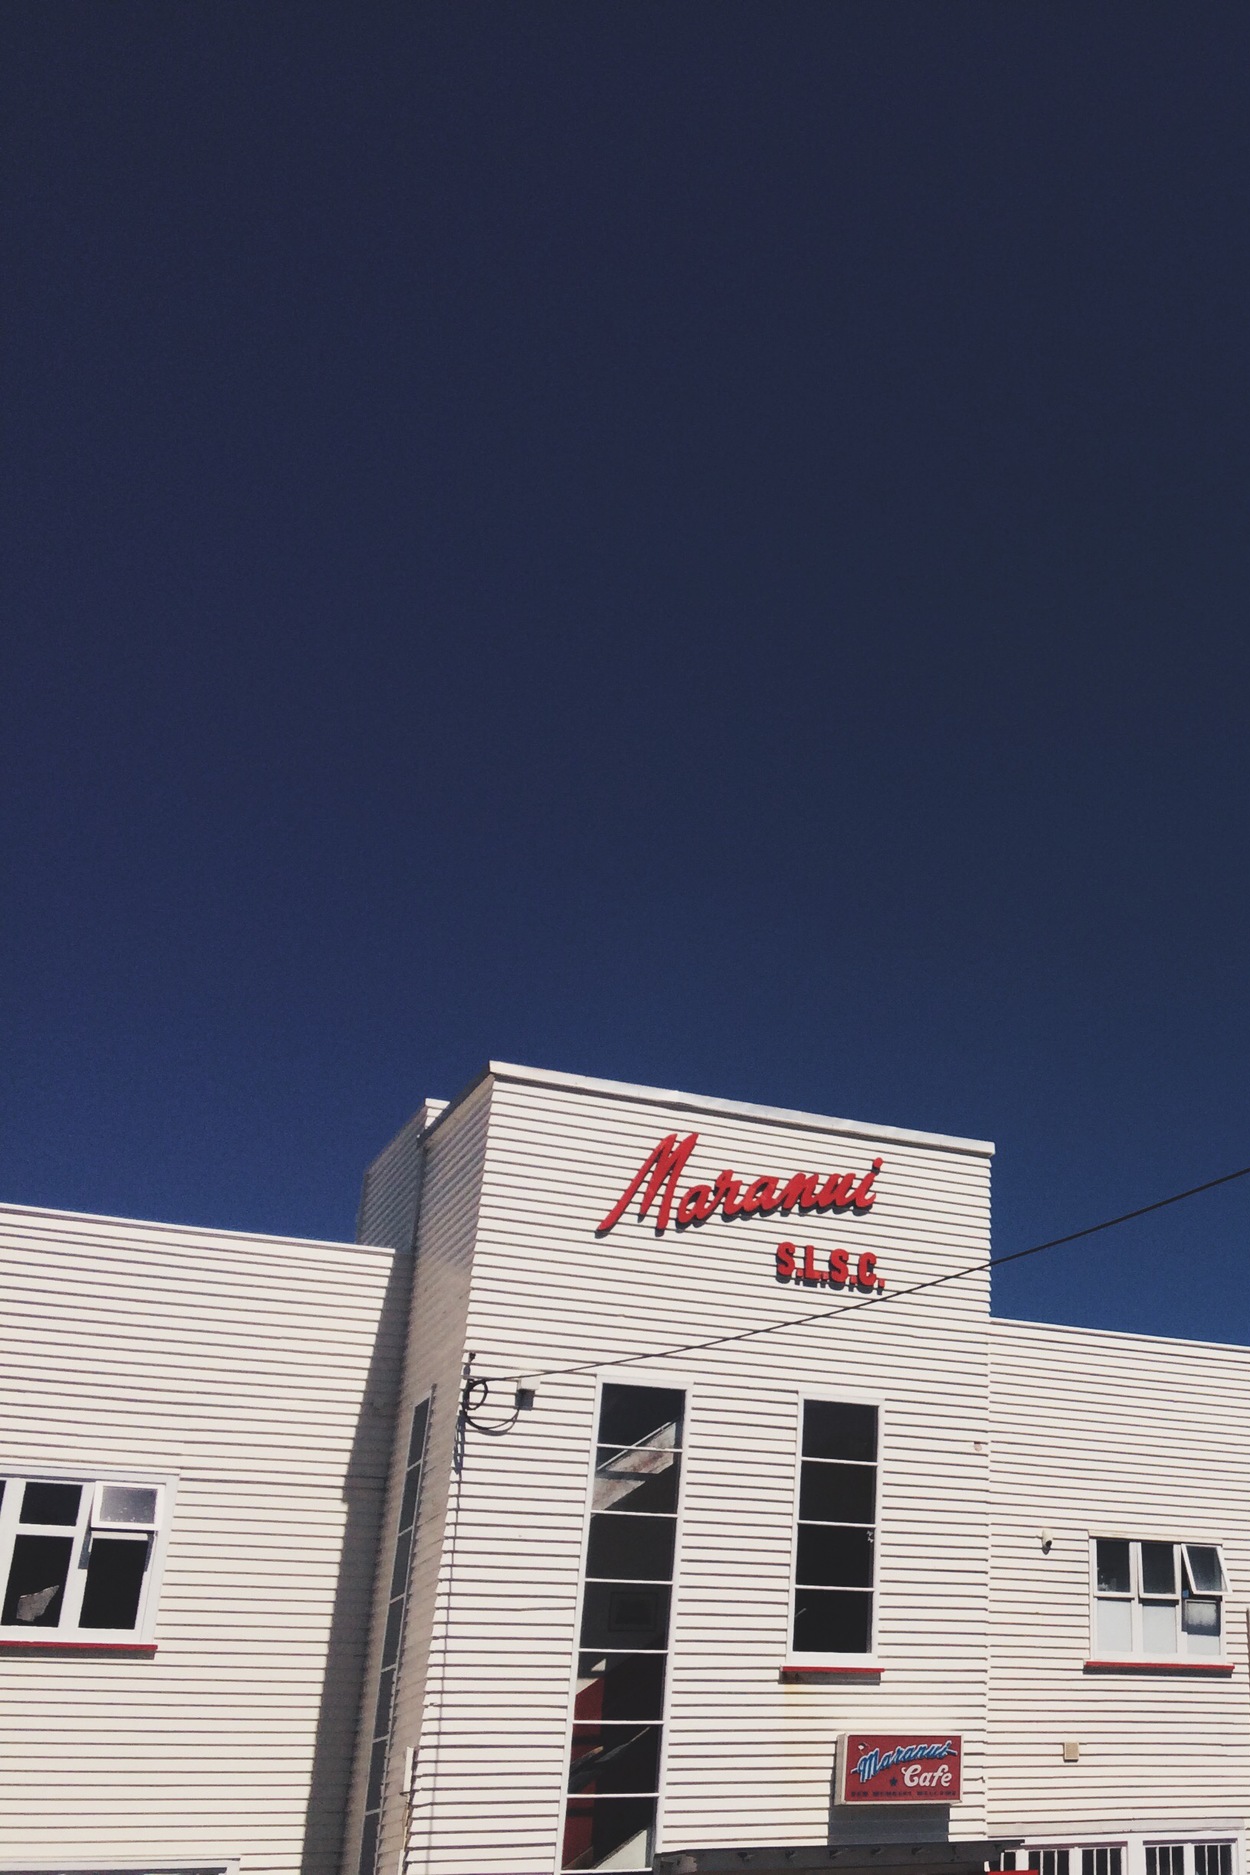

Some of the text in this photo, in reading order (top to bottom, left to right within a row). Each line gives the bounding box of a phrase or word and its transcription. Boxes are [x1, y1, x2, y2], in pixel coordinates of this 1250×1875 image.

[596, 1132, 884, 1231] Maranui
[776, 1241, 885, 1288] S.L.S.C.
[851, 1740, 958, 1782] Maranui
[901, 1764, 952, 1787] Cafe
